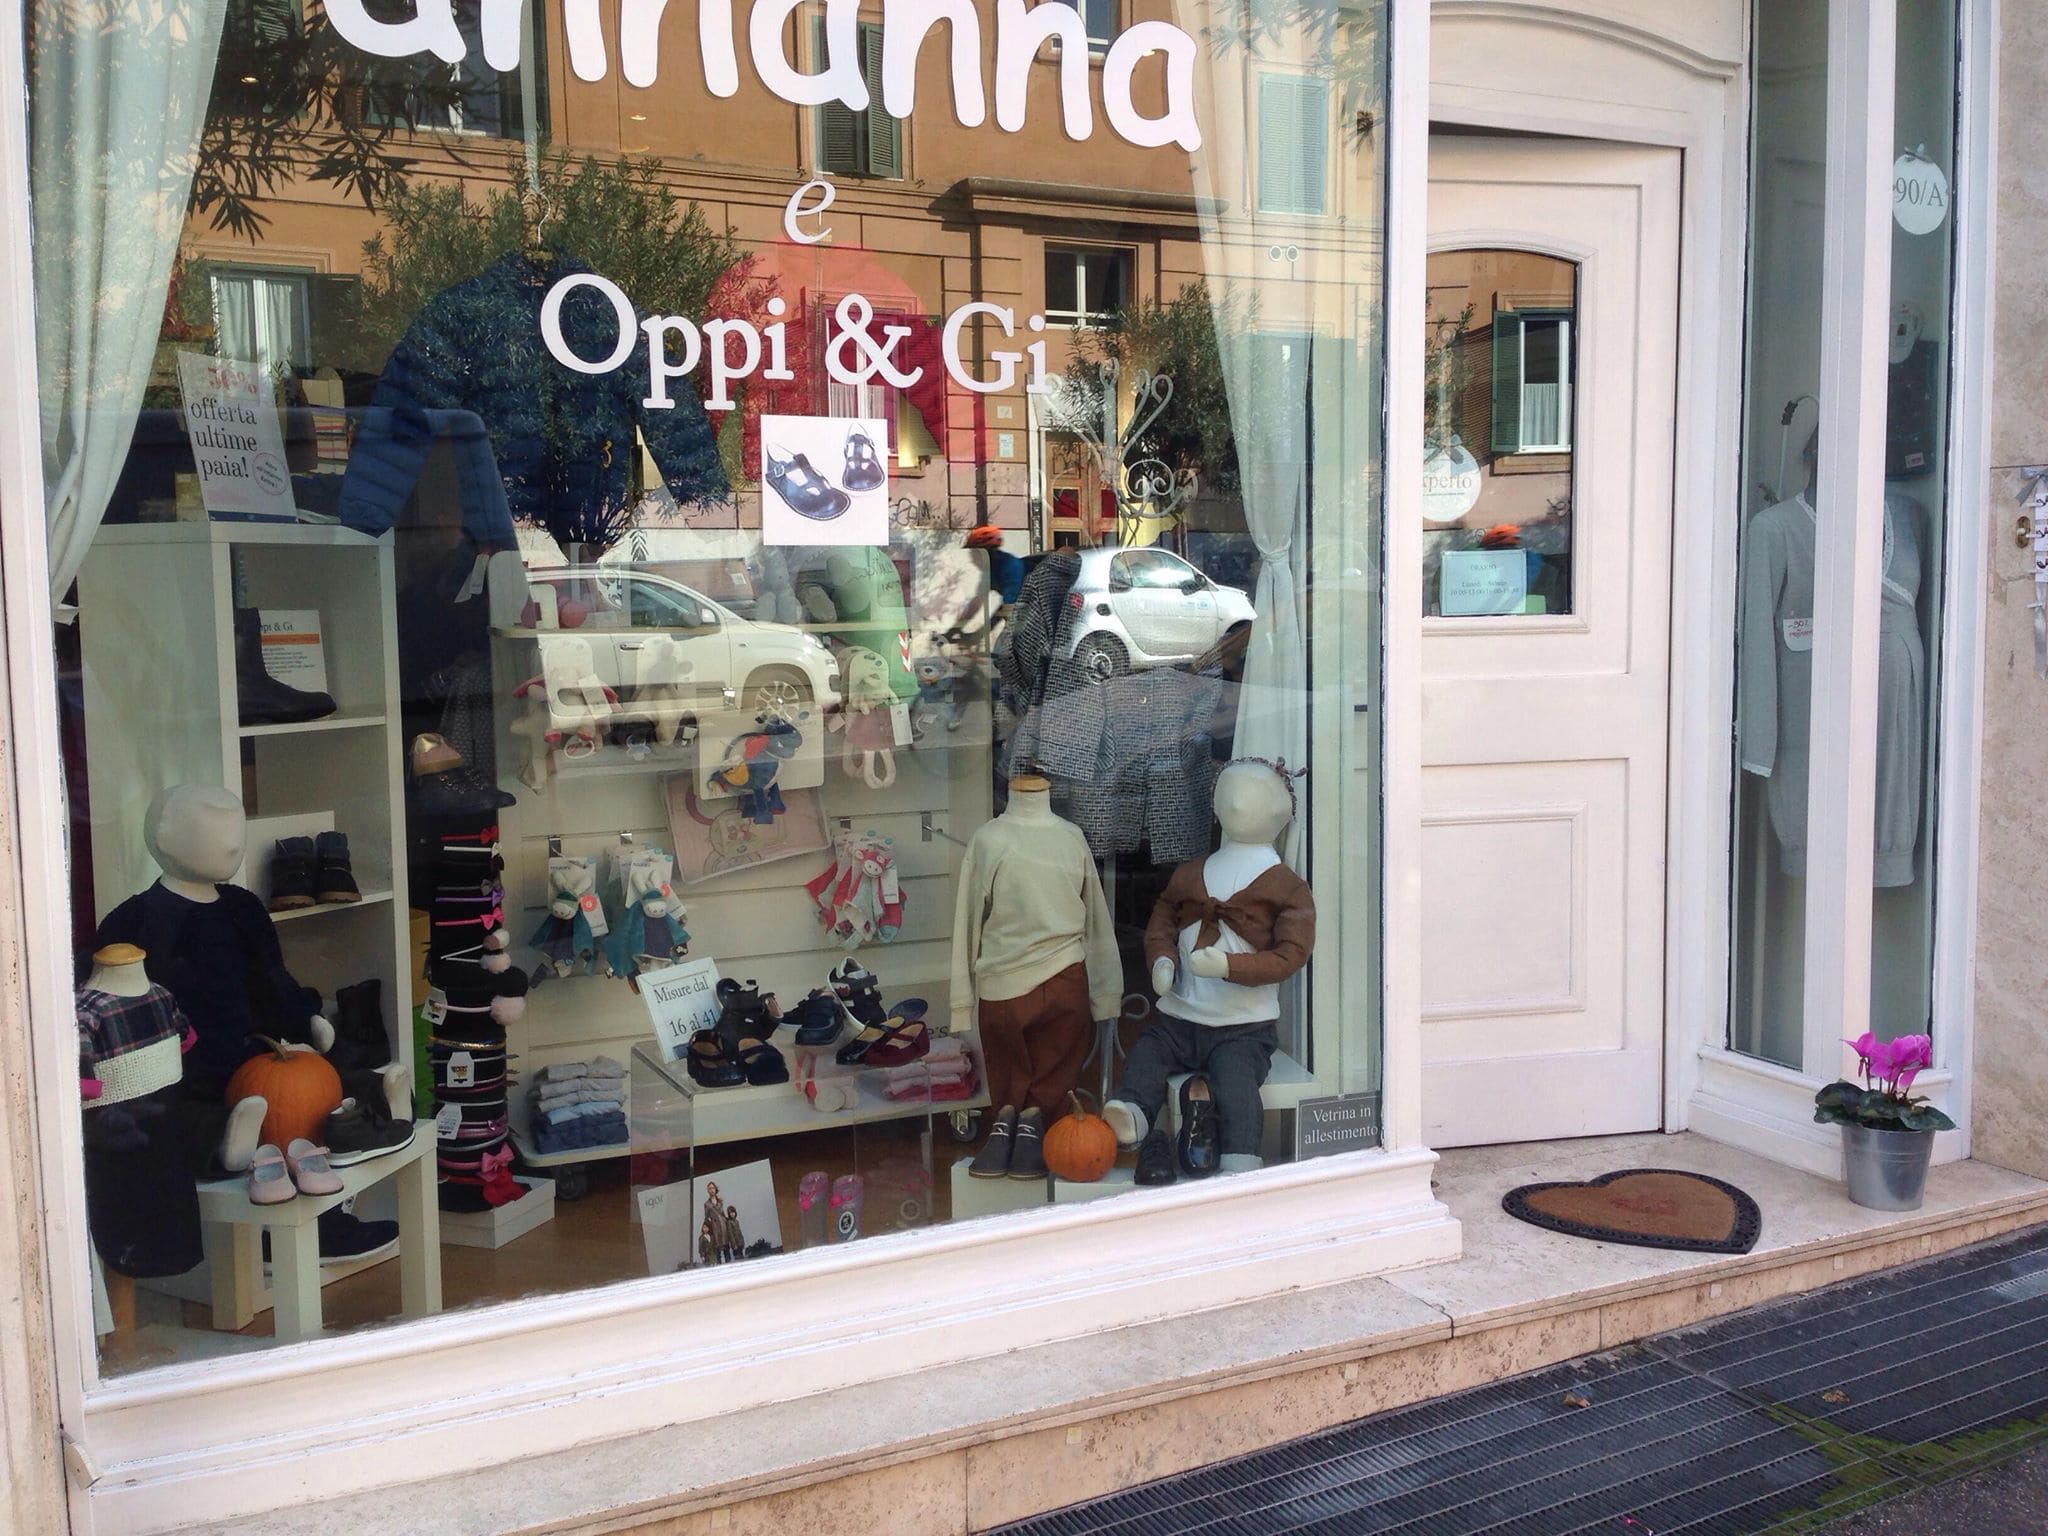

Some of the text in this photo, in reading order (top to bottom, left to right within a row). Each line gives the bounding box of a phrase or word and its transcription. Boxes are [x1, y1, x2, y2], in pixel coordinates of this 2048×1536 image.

[1895, 177, 1944, 207] 90/A
[784, 179, 836, 245] e
[540, 273, 1053, 410] Oppi & Gi
[191, 396, 257, 425] offerta
[195, 425, 258, 452] ultime
[200, 455, 249, 481] paia!
[653, 976, 709, 1004] Misure dal
[670, 1017, 687, 1037] 16
[689, 1013, 701, 1031] al
[1313, 1104, 1371, 1122] Vetrina in
[1304, 1125, 1378, 1144] allestimento
